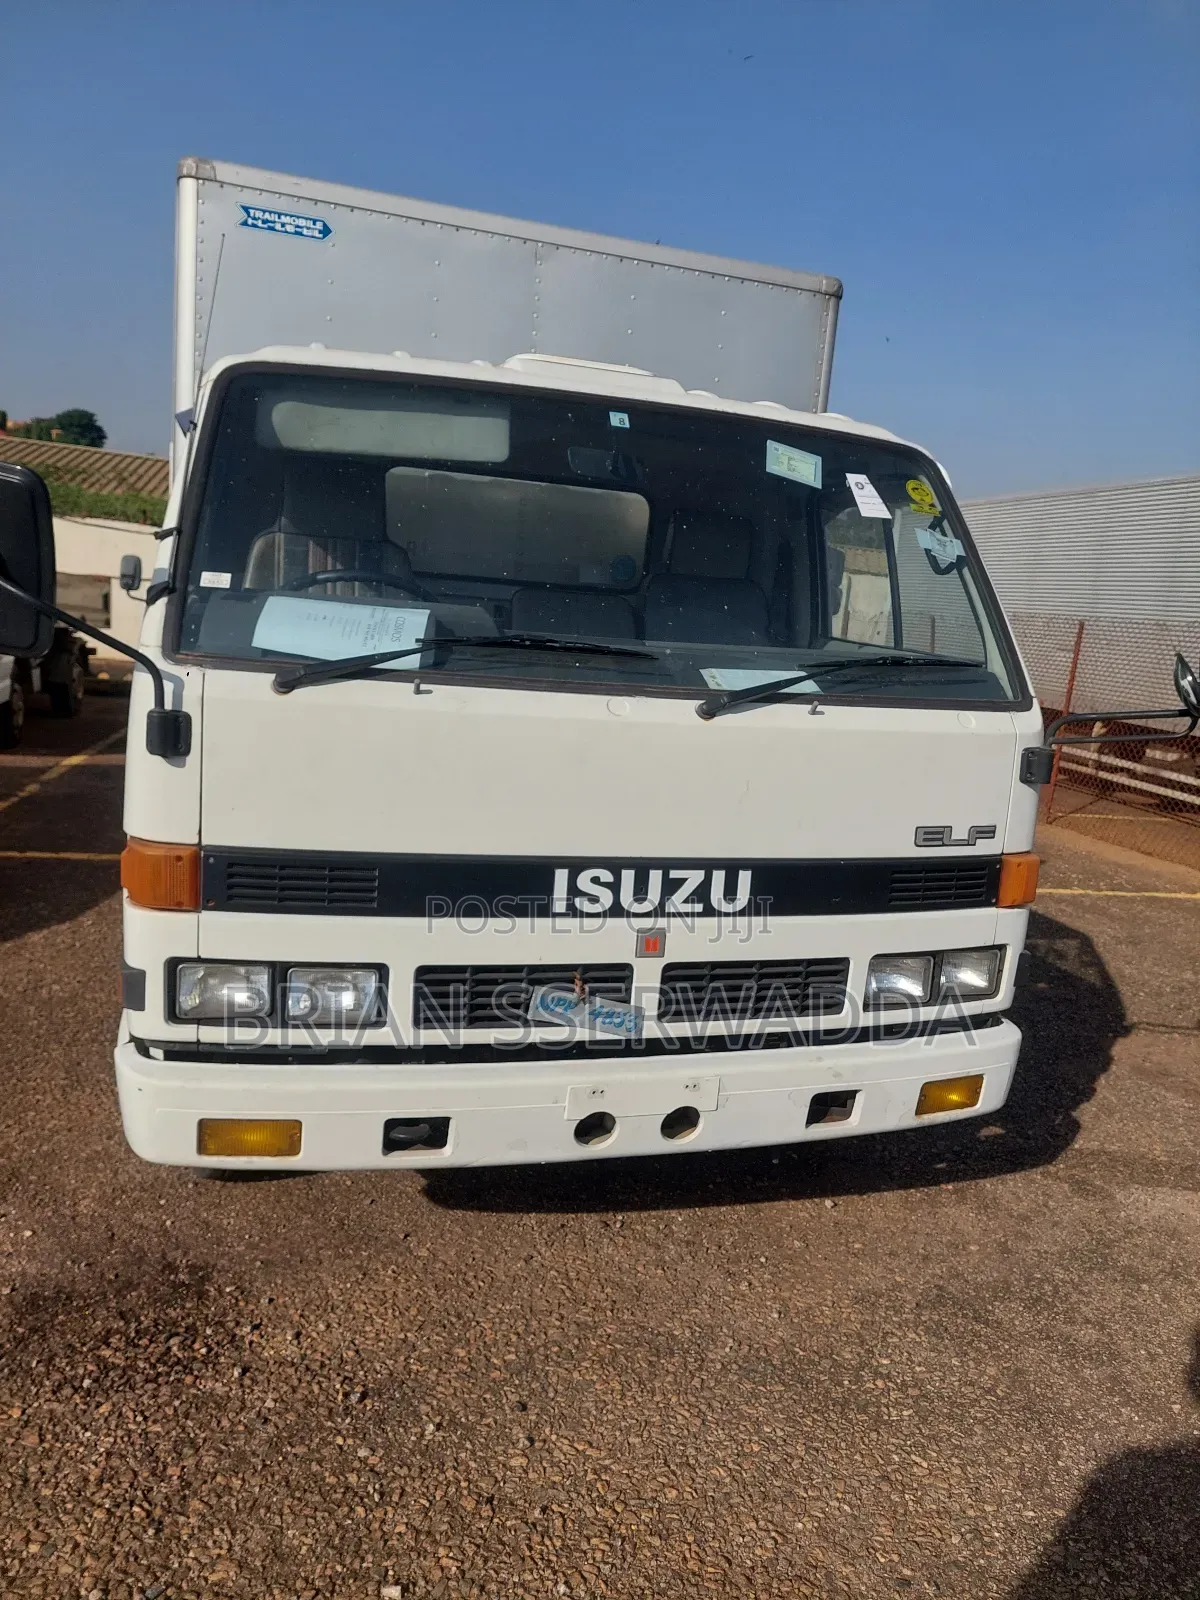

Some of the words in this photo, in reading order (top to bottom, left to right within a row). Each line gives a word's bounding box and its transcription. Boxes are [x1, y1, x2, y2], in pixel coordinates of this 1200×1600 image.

[248, 209, 324, 229] TRAILMOBILE
[618, 417, 626, 426] 8
[390, 616, 407, 643] COSMOS
[914, 825, 997, 847] ELF
[552, 868, 752, 914] ISUZU
